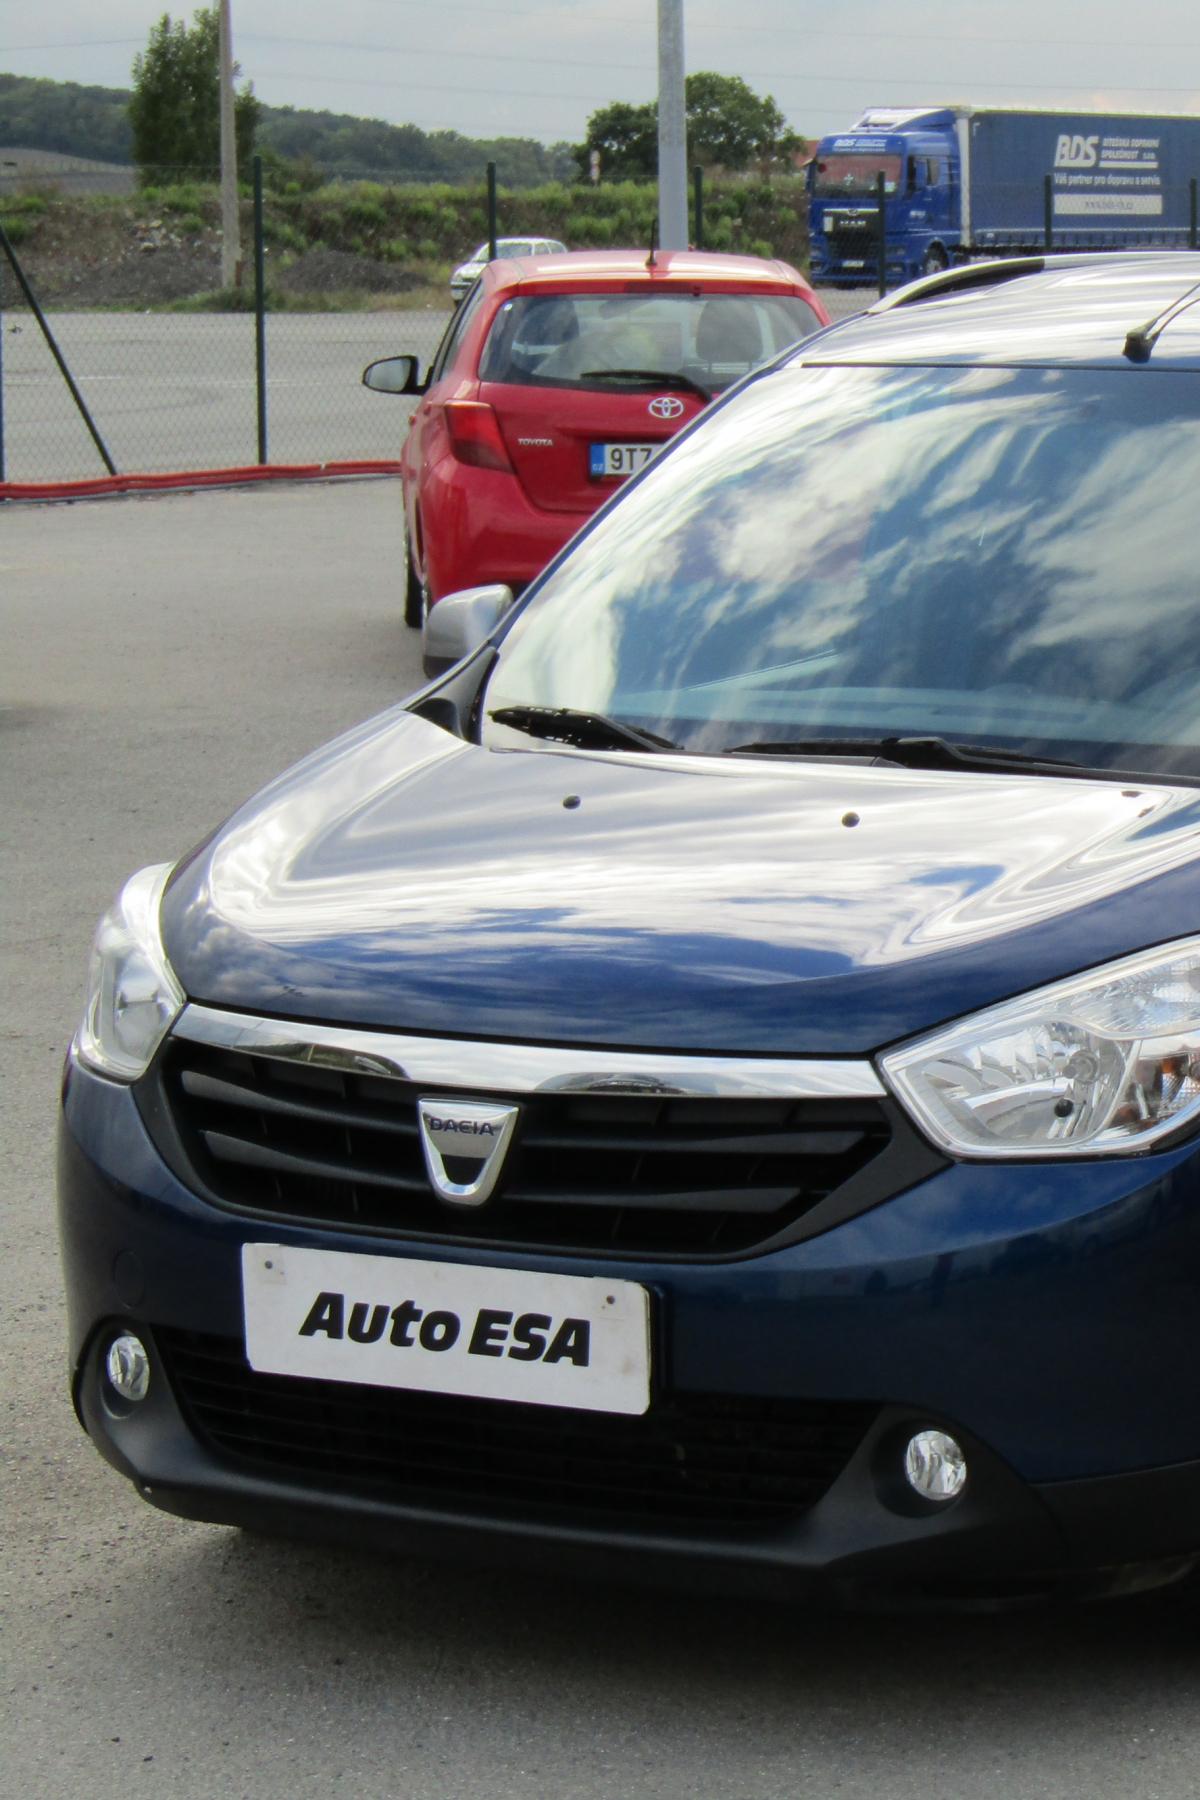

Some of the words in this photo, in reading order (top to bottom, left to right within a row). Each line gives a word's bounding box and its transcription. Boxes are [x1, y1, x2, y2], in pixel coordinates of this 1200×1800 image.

[1054, 134, 1099, 167] BDS
[1054, 172, 1067, 184] Váš
[1068, 175, 1093, 187] partner
[1094, 176, 1106, 187] pro
[1107, 174, 1135, 187] dopravu
[517, 438, 553, 446] TOYOTA
[429, 1117, 495, 1136] DACIA
[298, 1291, 460, 1352] Auto
[468, 1308, 591, 1367] ESA
